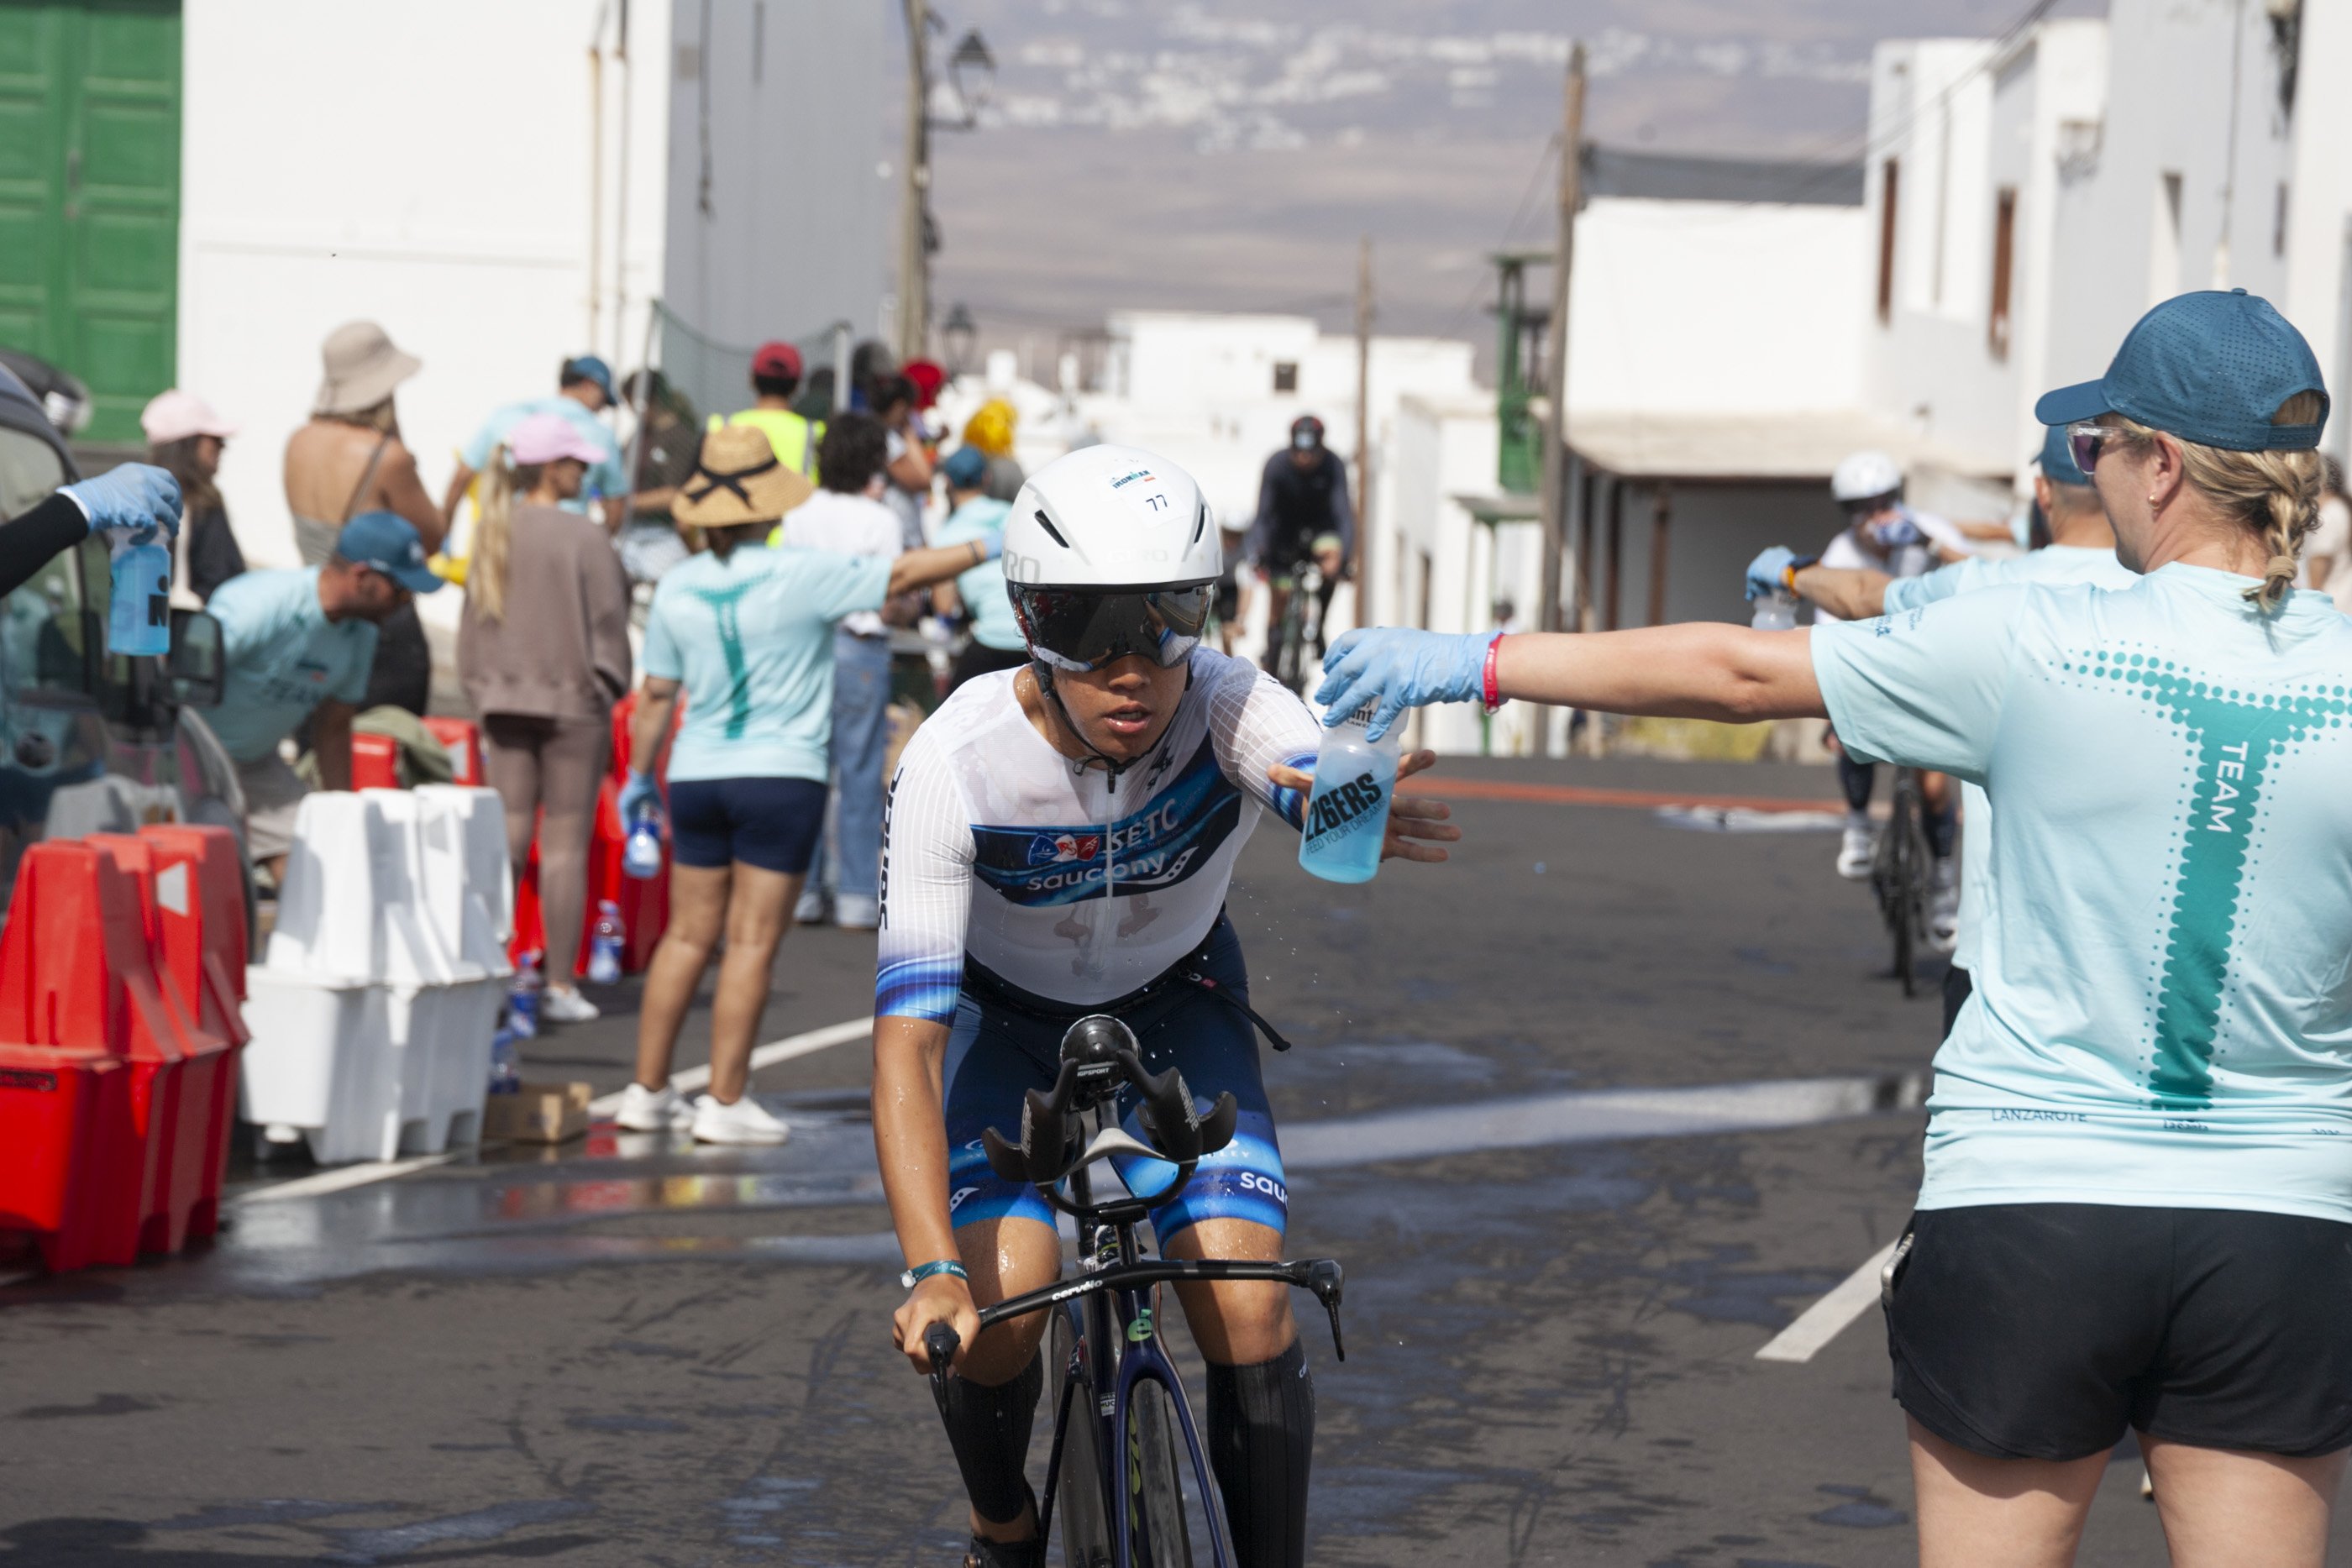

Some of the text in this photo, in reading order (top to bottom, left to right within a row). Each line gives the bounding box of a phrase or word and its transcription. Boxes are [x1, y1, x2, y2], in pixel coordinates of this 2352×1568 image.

[1146, 494, 1168, 511] 77
[2206, 741, 2249, 833] TEAM
[1100, 798, 1179, 855] SETC
[1324, 827, 1351, 845] YOUR
[1026, 852, 1166, 891] saucony
[1992, 1108, 2087, 1122] LANZAROTE
